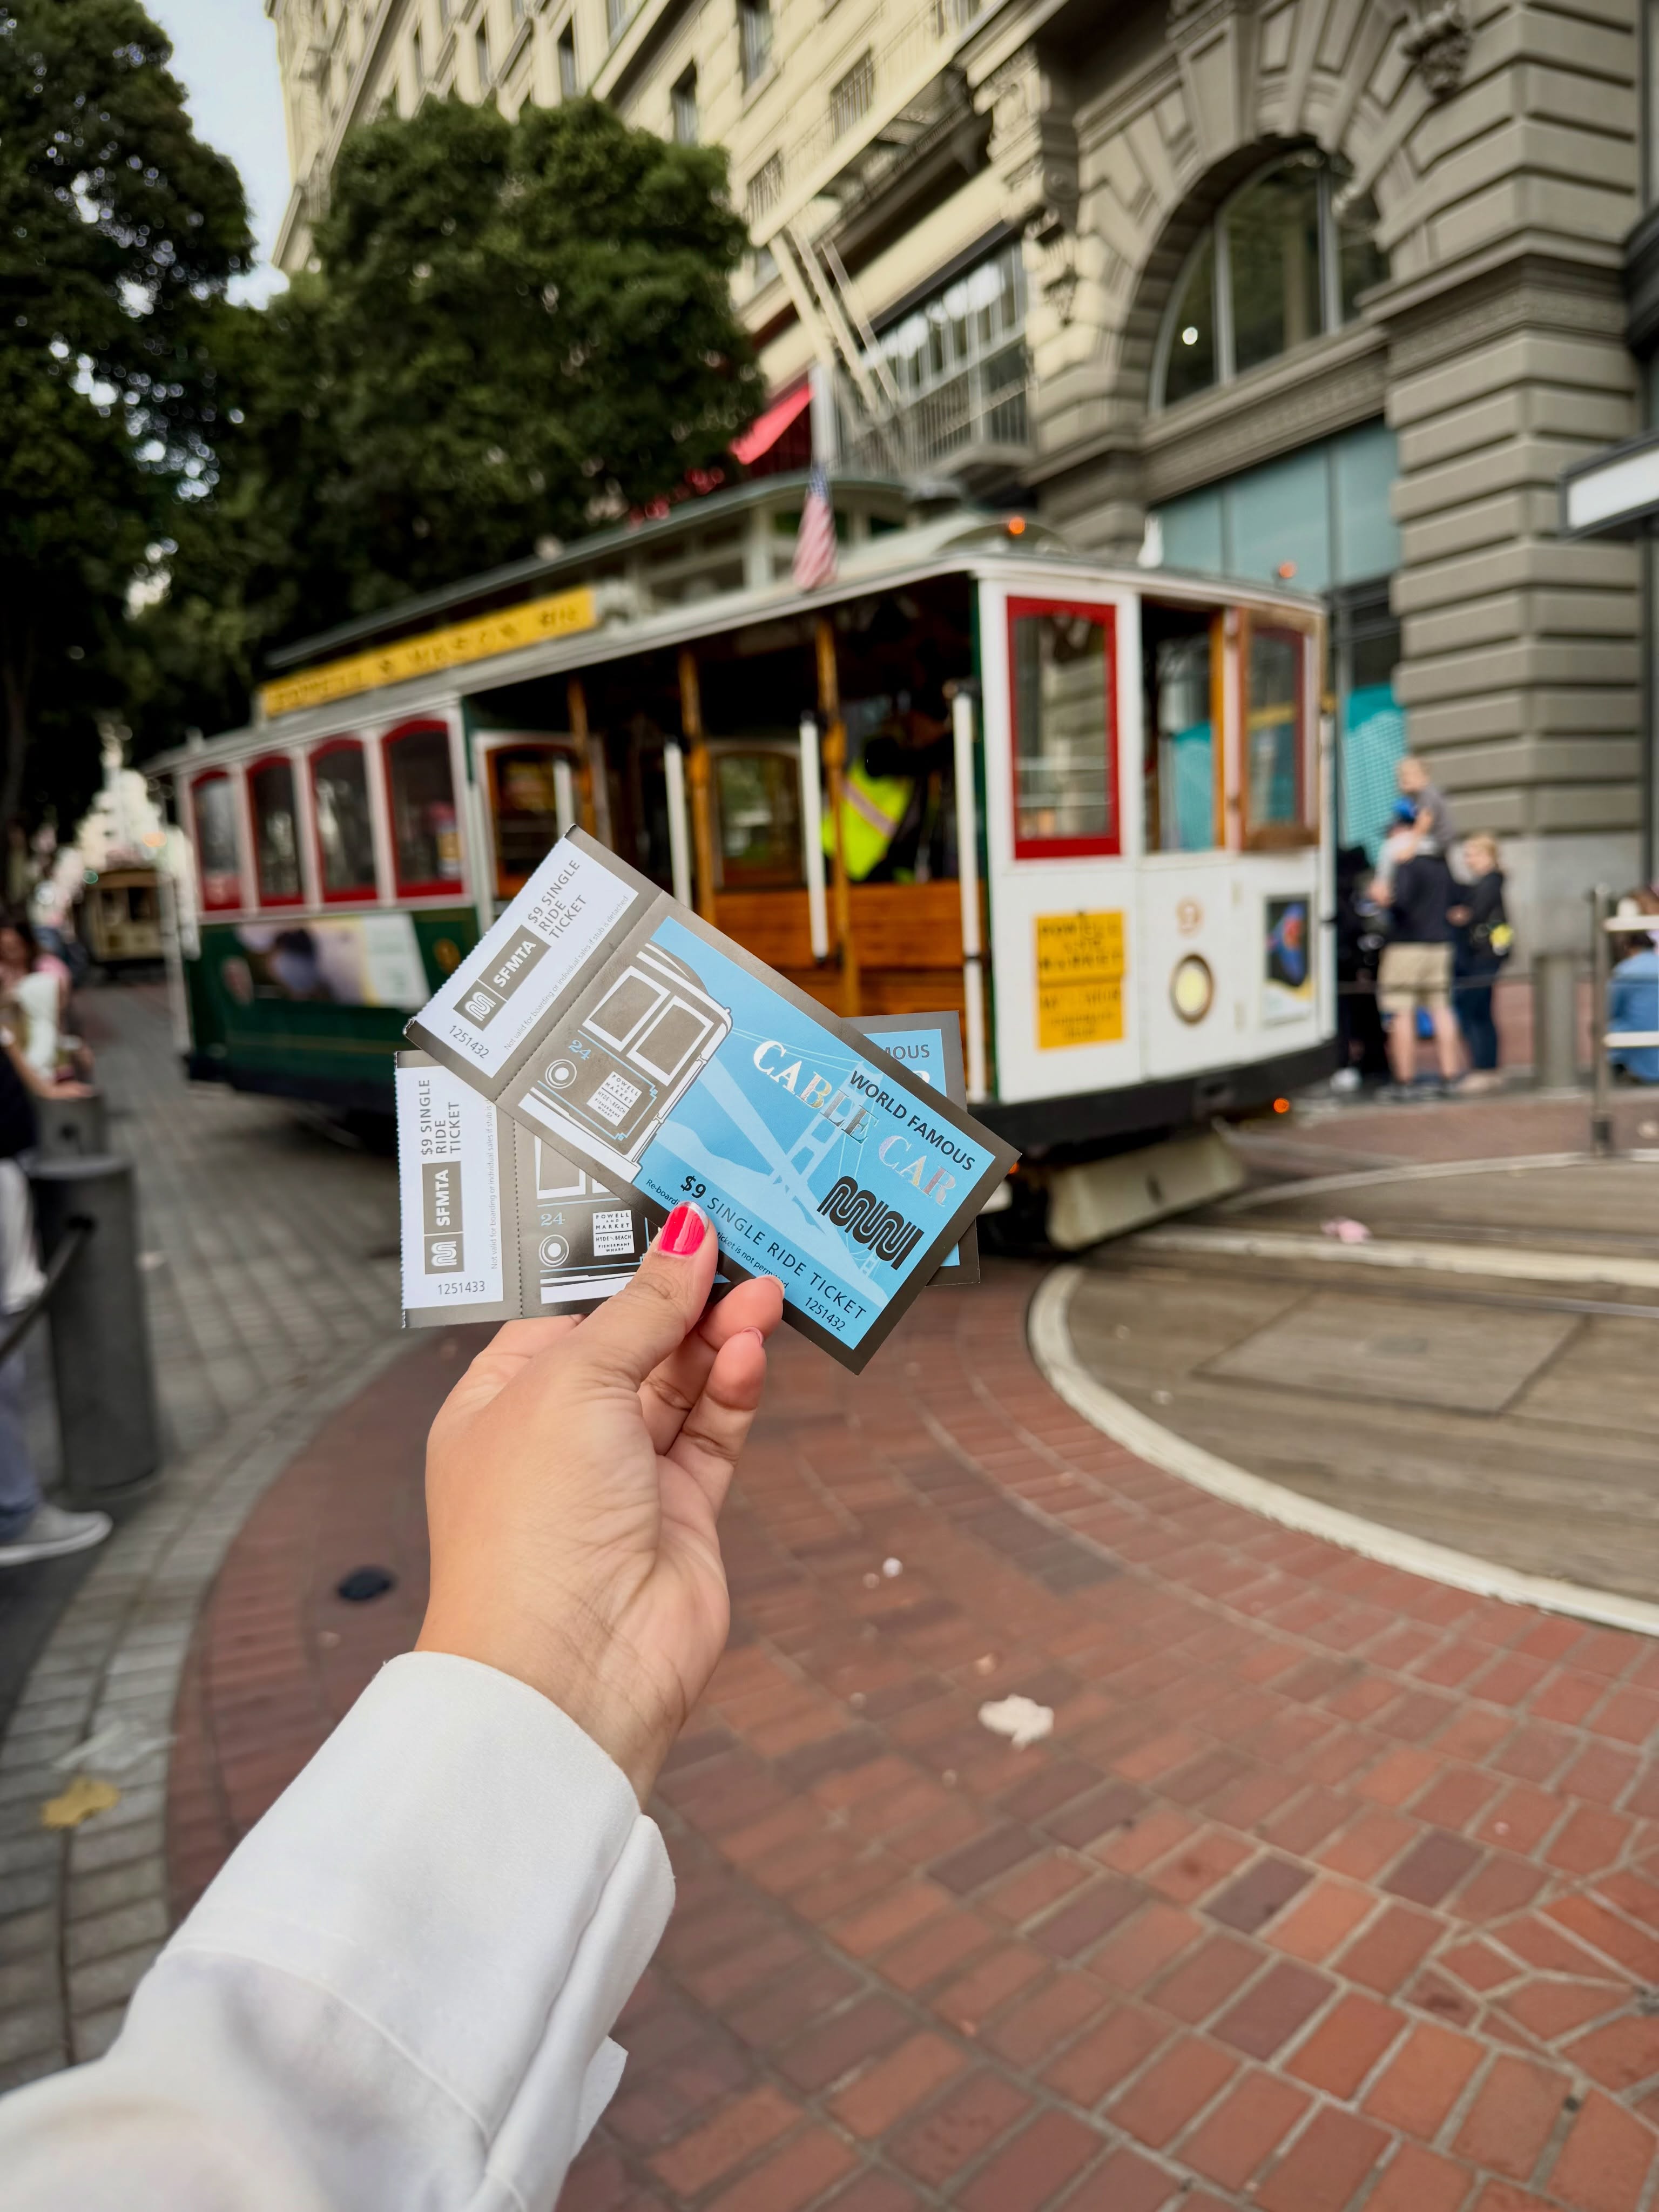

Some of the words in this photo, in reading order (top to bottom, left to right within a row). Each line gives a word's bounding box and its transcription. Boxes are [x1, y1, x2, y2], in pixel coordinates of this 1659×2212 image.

[528, 907, 543, 923] $9
[542, 860, 580, 906] SINGLE
[539, 900, 566, 932] RIDE
[549, 895, 586, 939] TICKET
[493, 941, 537, 987] SFMTA
[503, 1038, 516, 1050] Not
[514, 1024, 527, 1038] valid
[524, 1016, 533, 1025] for
[530, 992, 555, 1017] boarding
[557, 957, 579, 985] individual
[578, 945, 591, 959] sales
[593, 927, 604, 940] stub
[607, 895, 629, 922] detached
[449, 1025, 489, 1058] 1251432
[568, 1040, 591, 1060] 24
[885, 1044, 930, 1060] OUS
[605, 1082, 633, 1104] MARKET
[612, 1074, 638, 1096] POWELL
[616, 1084, 628, 1094] AND
[419, 1080, 431, 1132] SINGLE
[598, 1091, 609, 1102] HYDE
[612, 1102, 626, 1114] BEACH
[598, 1106, 613, 1117] WHARF
[448, 1102, 461, 1154] TICKET
[753, 1041, 879, 1144] CABLE
[879, 1135, 956, 1207] CAR
[849, 1070, 907, 1119] WORLD
[907, 1115, 975, 1170] FAMOUS
[421, 1139, 433, 1155] $9
[435, 1120, 447, 1154] RIDE
[435, 1169, 450, 1226] SFMTA
[489, 1195, 497, 1225] boarding
[541, 1212, 565, 1226] 24
[646, 1179, 680, 1206] Re-boardi
[717, 1231, 735, 1249] ticket
[735, 1246, 741, 1254] is
[741, 1252, 754, 1263] not
[753, 1262, 790, 1289] permd
[680, 1175, 706, 1198] $9
[707, 1197, 765, 1245] SINGLE
[767, 1242, 807, 1276] RIDE
[810, 1272, 866, 1319] TICKET
[437, 1280, 485, 1295] 1251433
[805, 1297, 845, 1332] 1251432
